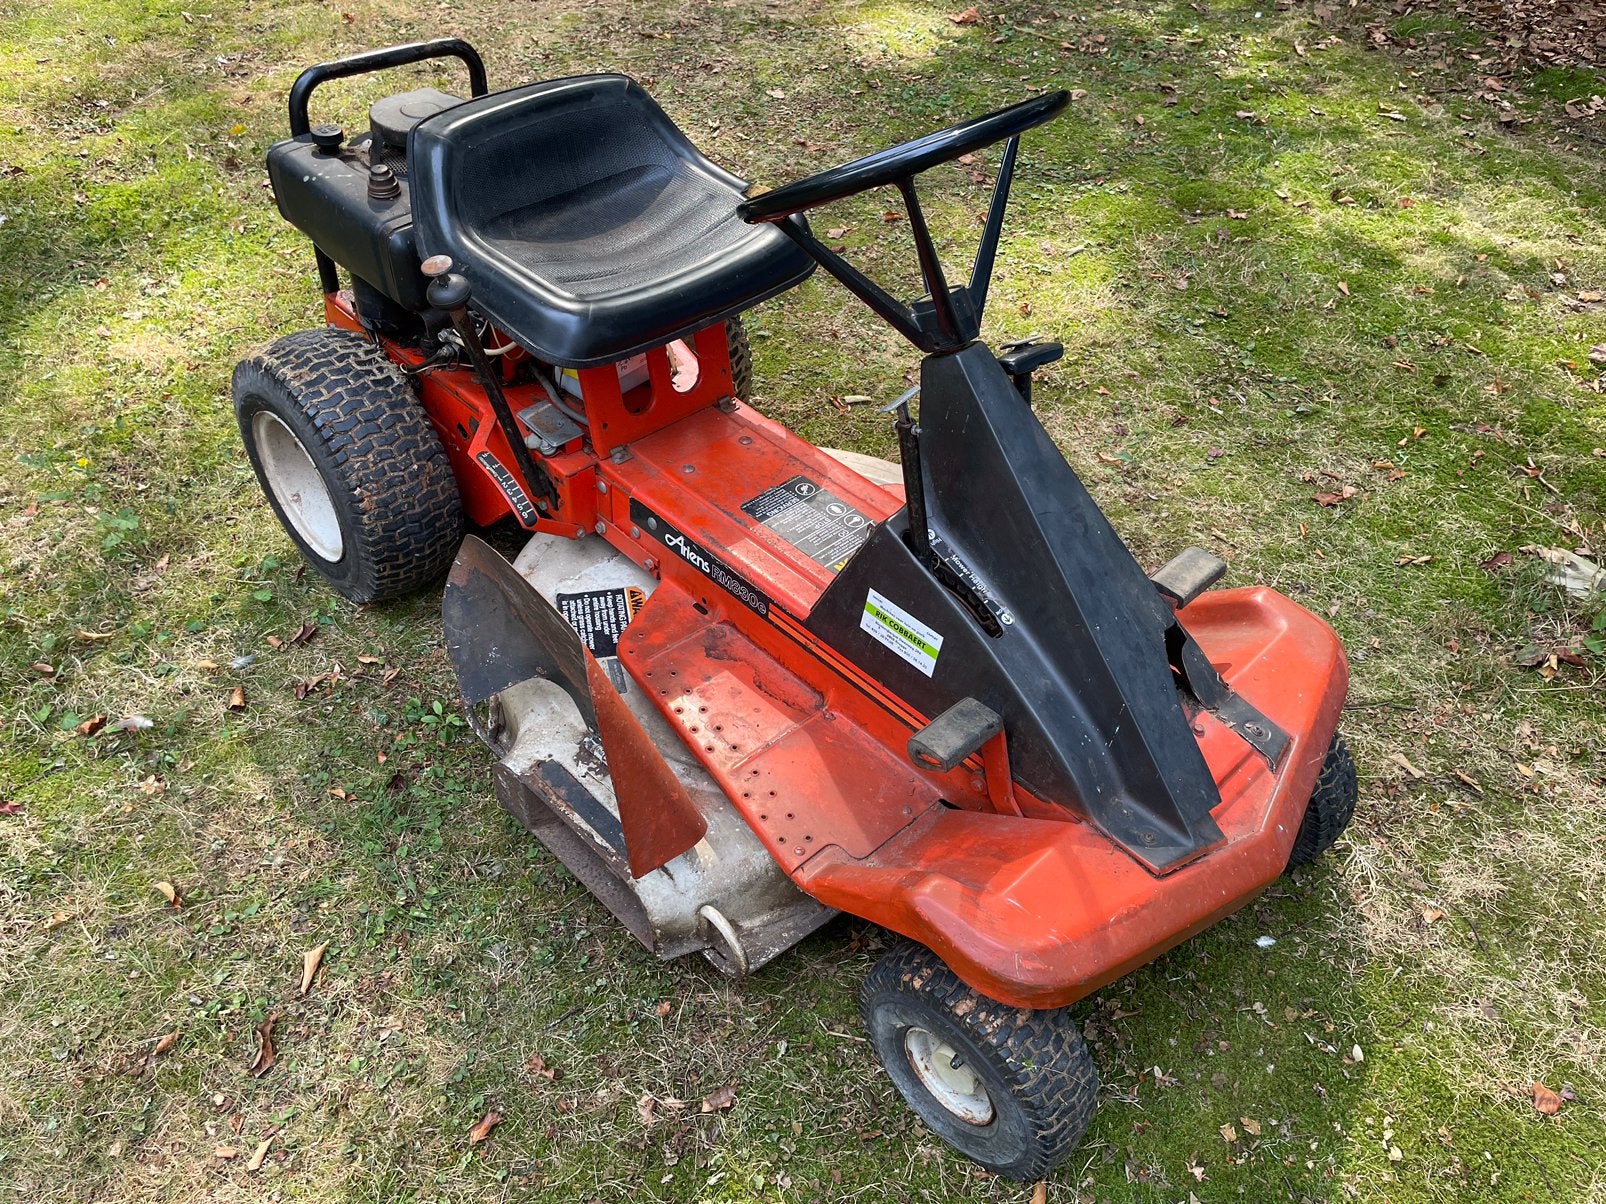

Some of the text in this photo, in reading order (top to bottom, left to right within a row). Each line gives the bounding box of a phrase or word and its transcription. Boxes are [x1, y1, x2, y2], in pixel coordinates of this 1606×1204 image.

[664, 533, 710, 574] Ariens
[950, 554, 970, 575] Mower
[876, 610, 887, 622] RIK
[889, 620, 926, 649] COBBAERT
